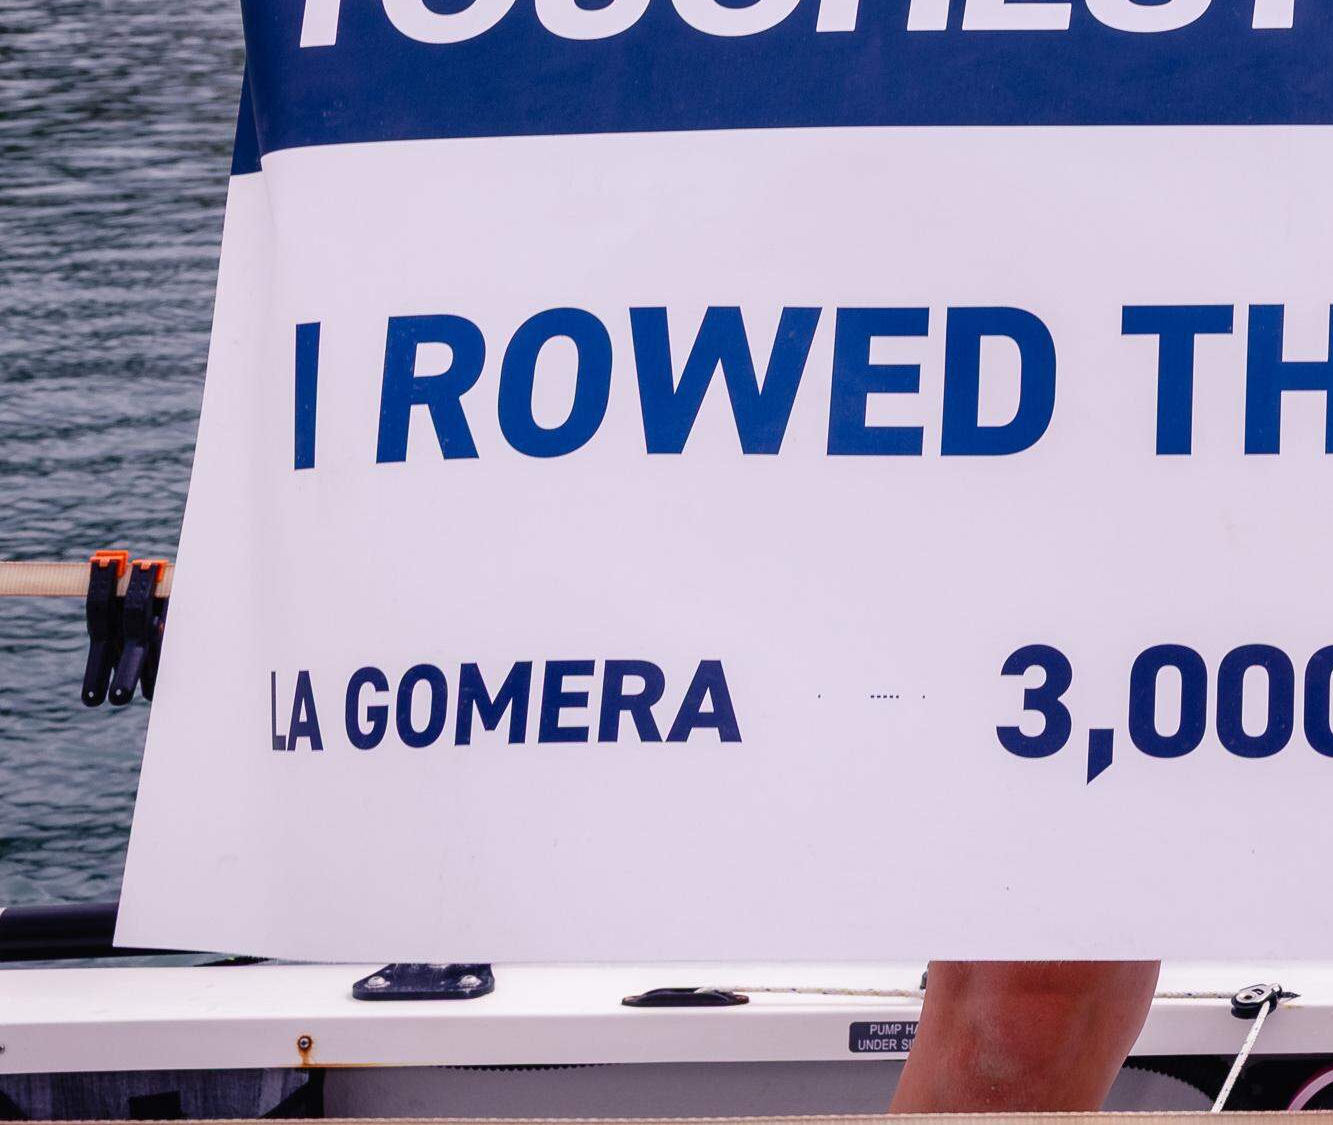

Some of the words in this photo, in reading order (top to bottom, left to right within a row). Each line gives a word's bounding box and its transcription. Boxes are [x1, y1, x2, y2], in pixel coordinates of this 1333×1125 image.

[294, 322, 321, 470] I
[376, 306, 1056, 464] ROWED
[271, 670, 324, 752] LA
[344, 660, 742, 751] GOMERA
[858, 1039, 897, 1051] UNDER
[870, 1024, 901, 1035] PUMP
